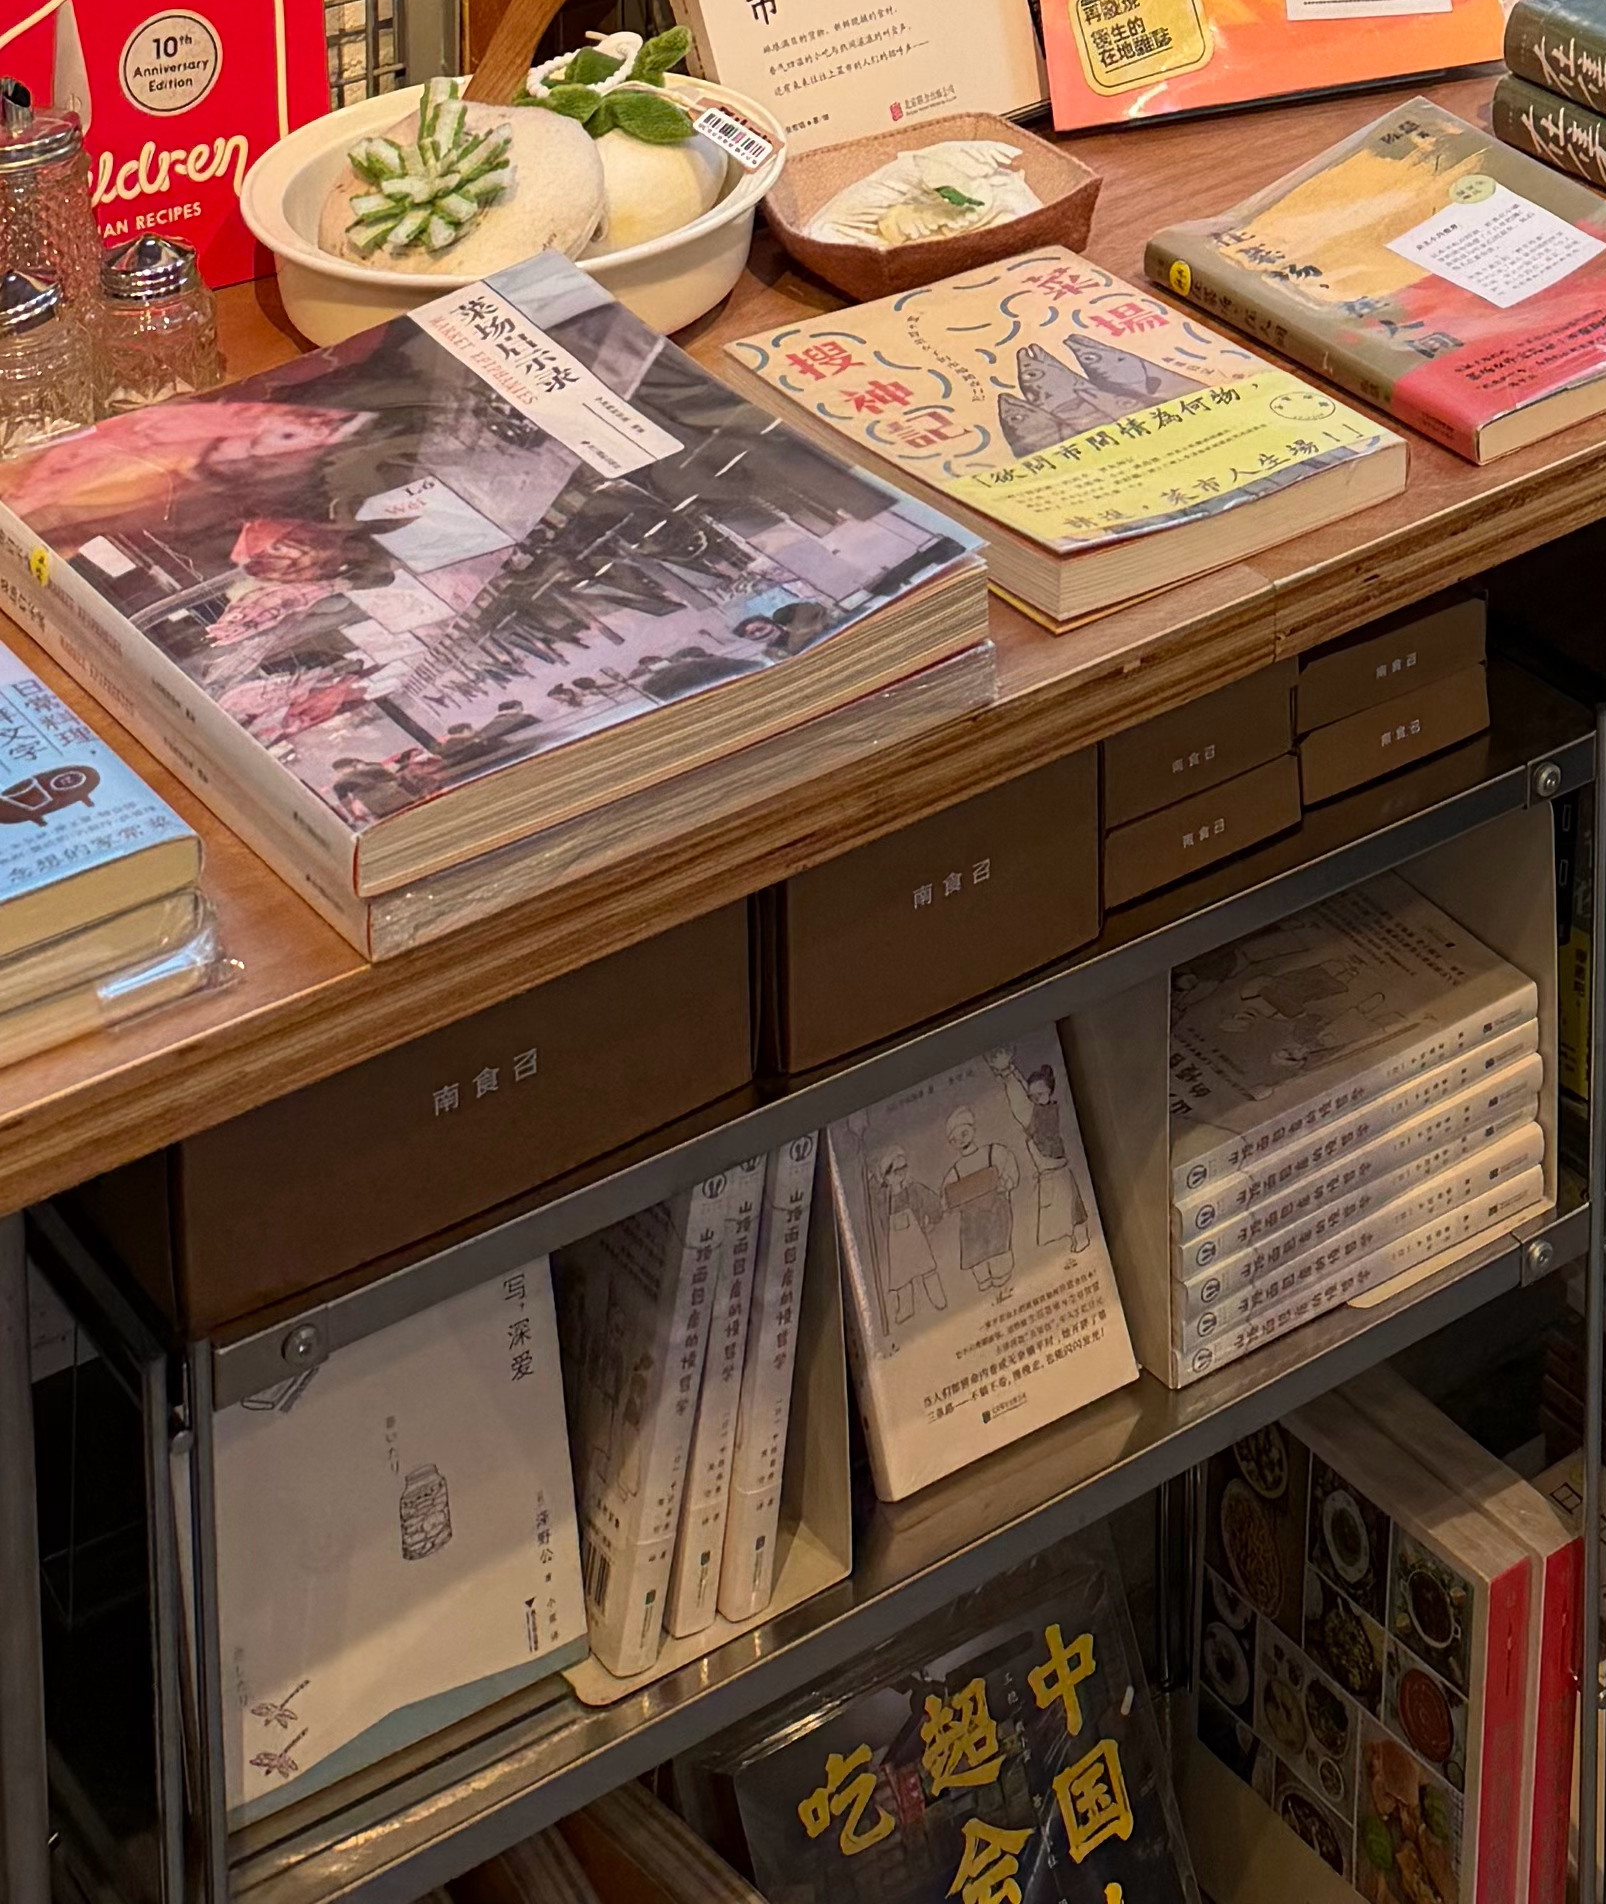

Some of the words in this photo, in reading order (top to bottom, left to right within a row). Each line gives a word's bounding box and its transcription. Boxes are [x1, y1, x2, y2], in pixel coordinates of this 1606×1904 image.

[151, 34, 194, 61] 10th
[132, 57, 210, 82] Anniversary
[148, 75, 194, 94] Edition
[135, 200, 202, 232] RECIPES
[1020, 265, 1171, 337] 菜場
[449, 295, 581, 393] 菜场启示录
[429, 315, 475, 355] MARKET
[469, 349, 539, 407] EPIPHANIES
[784, 340, 973, 450] 搜神記
[1375, 652, 1418, 681] 南食召
[1380, 719, 1423, 749] 南食召
[1171, 743, 1218, 774] 南食召
[1182, 818, 1228, 850] 南食召
[911, 858, 992, 910] 南食召
[431, 1049, 539, 1117] 南食召
[797, 1743, 895, 1856] 吃
